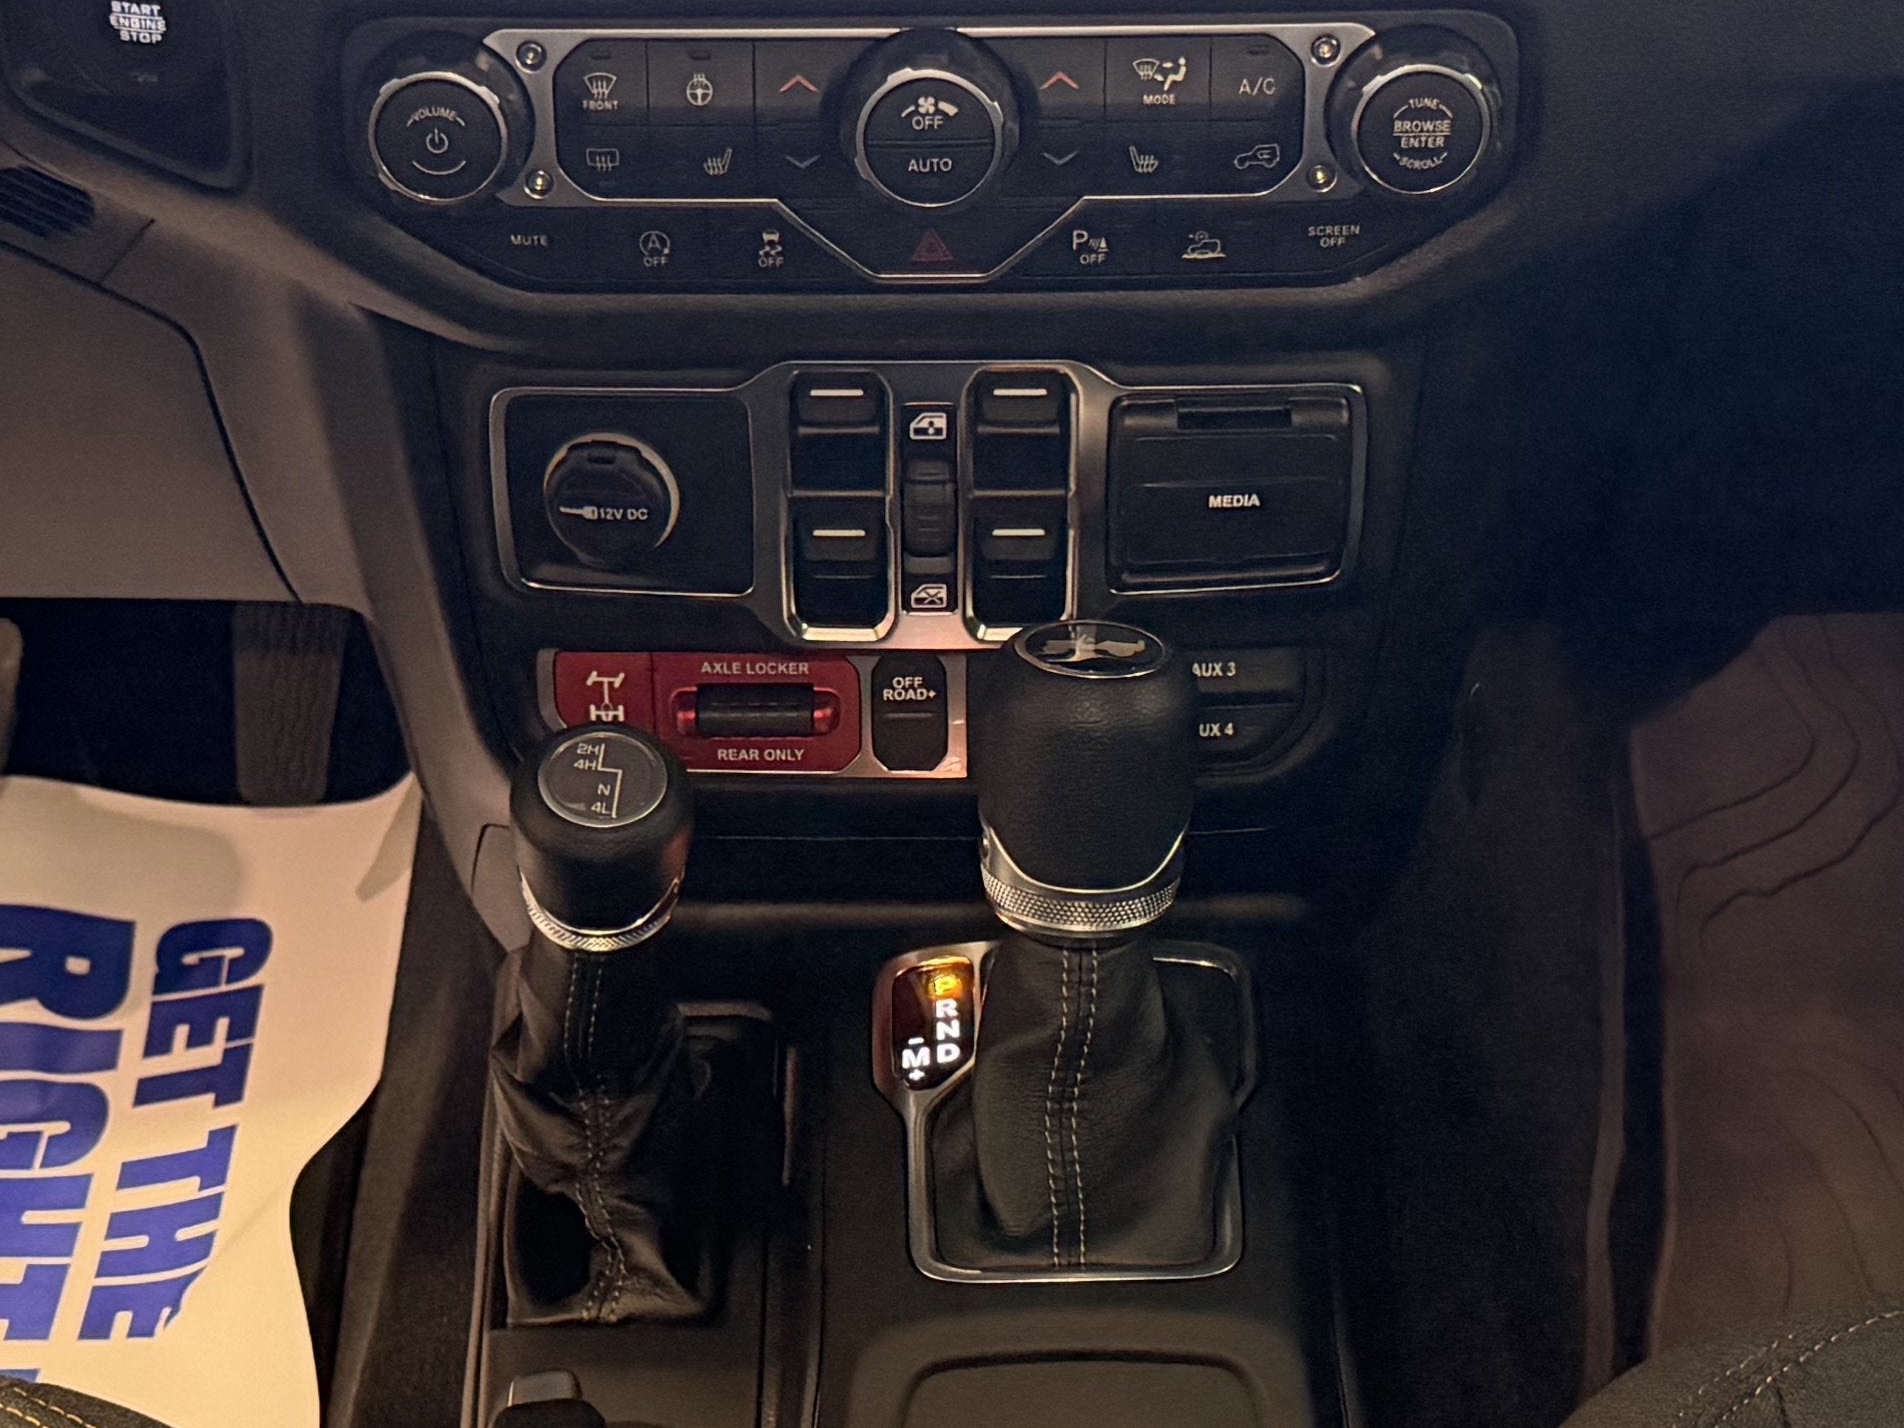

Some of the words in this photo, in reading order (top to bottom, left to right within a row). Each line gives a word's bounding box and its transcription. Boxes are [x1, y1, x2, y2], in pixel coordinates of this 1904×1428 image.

[110, 0, 161, 17] START
[110, 15, 167, 33] ENGINE
[120, 31, 162, 45] STOP
[1238, 76, 1276, 95] A/C
[583, 100, 619, 110] FRONT
[1143, 94, 1176, 106] MODE
[1408, 97, 1441, 110] TUNE
[411, 107, 457, 122] VOLUME
[911, 116, 944, 131] OFF
[1393, 120, 1451, 134] BROWSE
[1400, 136, 1445, 149] ENTER
[907, 158, 953, 173] AUTO
[1398, 155, 1443, 170] SCROLL
[1308, 225, 1360, 238] SCREEN
[510, 234, 548, 247] MUTE
[1319, 237, 1346, 249] OFF
[643, 256, 668, 268] OFF
[757, 256, 784, 268] OFF
[1079, 253, 1106, 265] OFF
[1208, 494, 1260, 508] MEDIA
[599, 507, 623, 520] 12V
[627, 508, 648, 520] DC
[701, 661, 741, 675] AXLE
[746, 661, 809, 675] LOCKER
[1192, 663, 1223, 677] AUX
[1226, 662, 1236, 677] 3
[893, 677, 923, 689] OFF
[1199, 723, 1221, 738] UX
[1224, 723, 1234, 737] 4
[576, 744, 600, 755] 2H
[717, 749, 760, 762] REAR
[764, 749, 805, 762] ONLY
[574, 759, 597, 772] 4H
[597, 783, 610, 796] N
[591, 803, 610, 816] 4L
[133, 918, 274, 1109] GET
[936, 998, 959, 1018] R
[936, 1020, 960, 1041] N
[902, 1047, 930, 1069] M
[937, 1043, 960, 1063] D
[77, 1124, 239, 1341] THE
